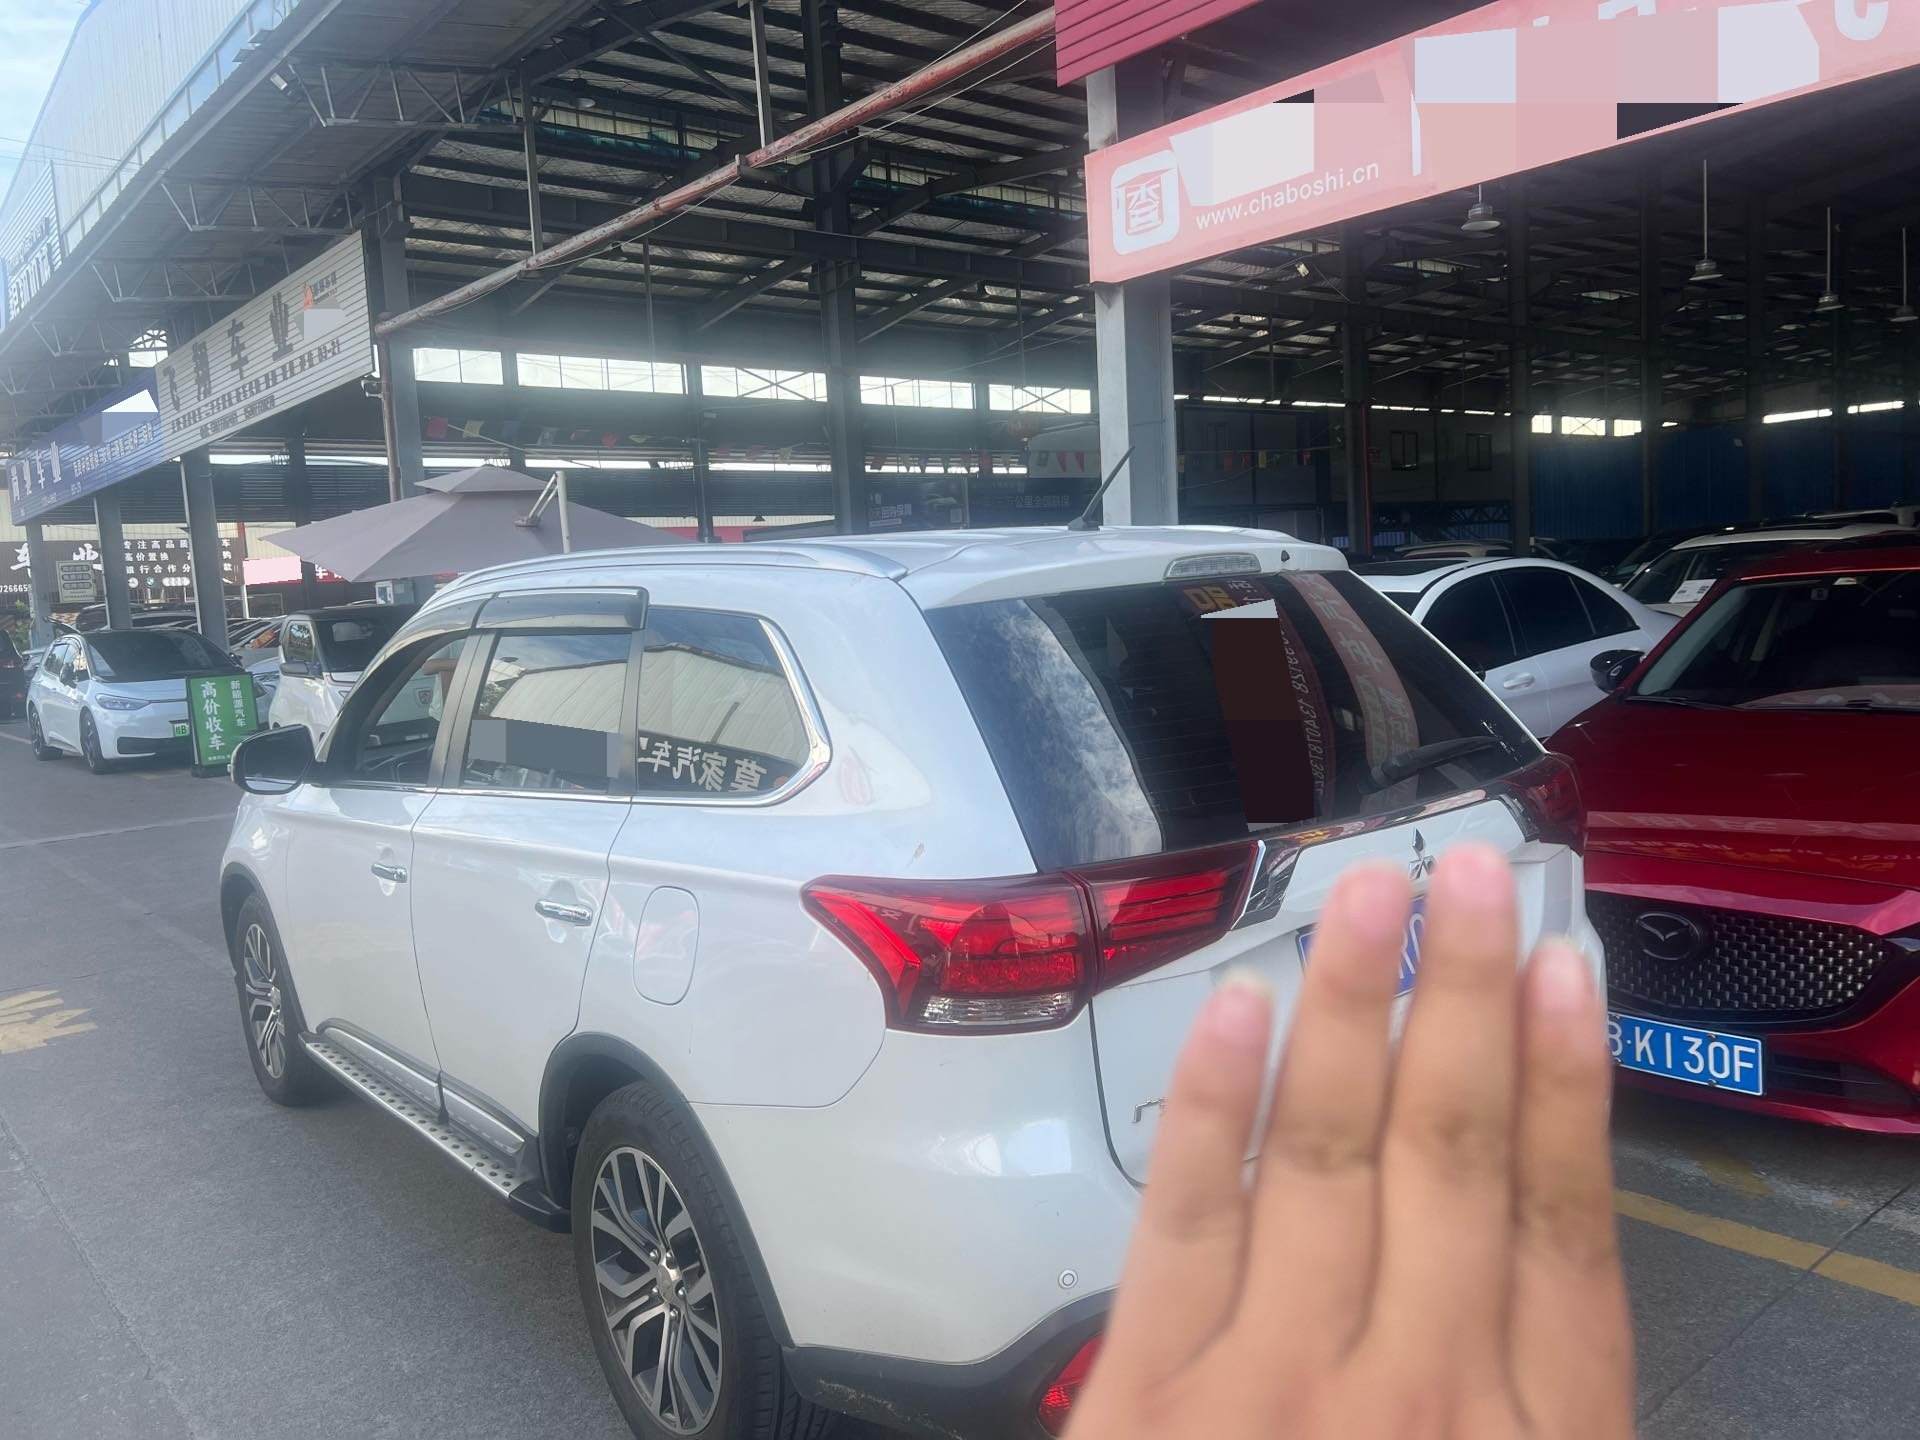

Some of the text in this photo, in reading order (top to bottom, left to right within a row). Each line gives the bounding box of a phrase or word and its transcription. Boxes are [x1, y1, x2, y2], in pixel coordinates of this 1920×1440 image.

[1196, 162, 1380, 230] www.chaboshi.cn
[201, 681, 225, 750] 高价收车
[230, 680, 247, 727] 新能源汽车
